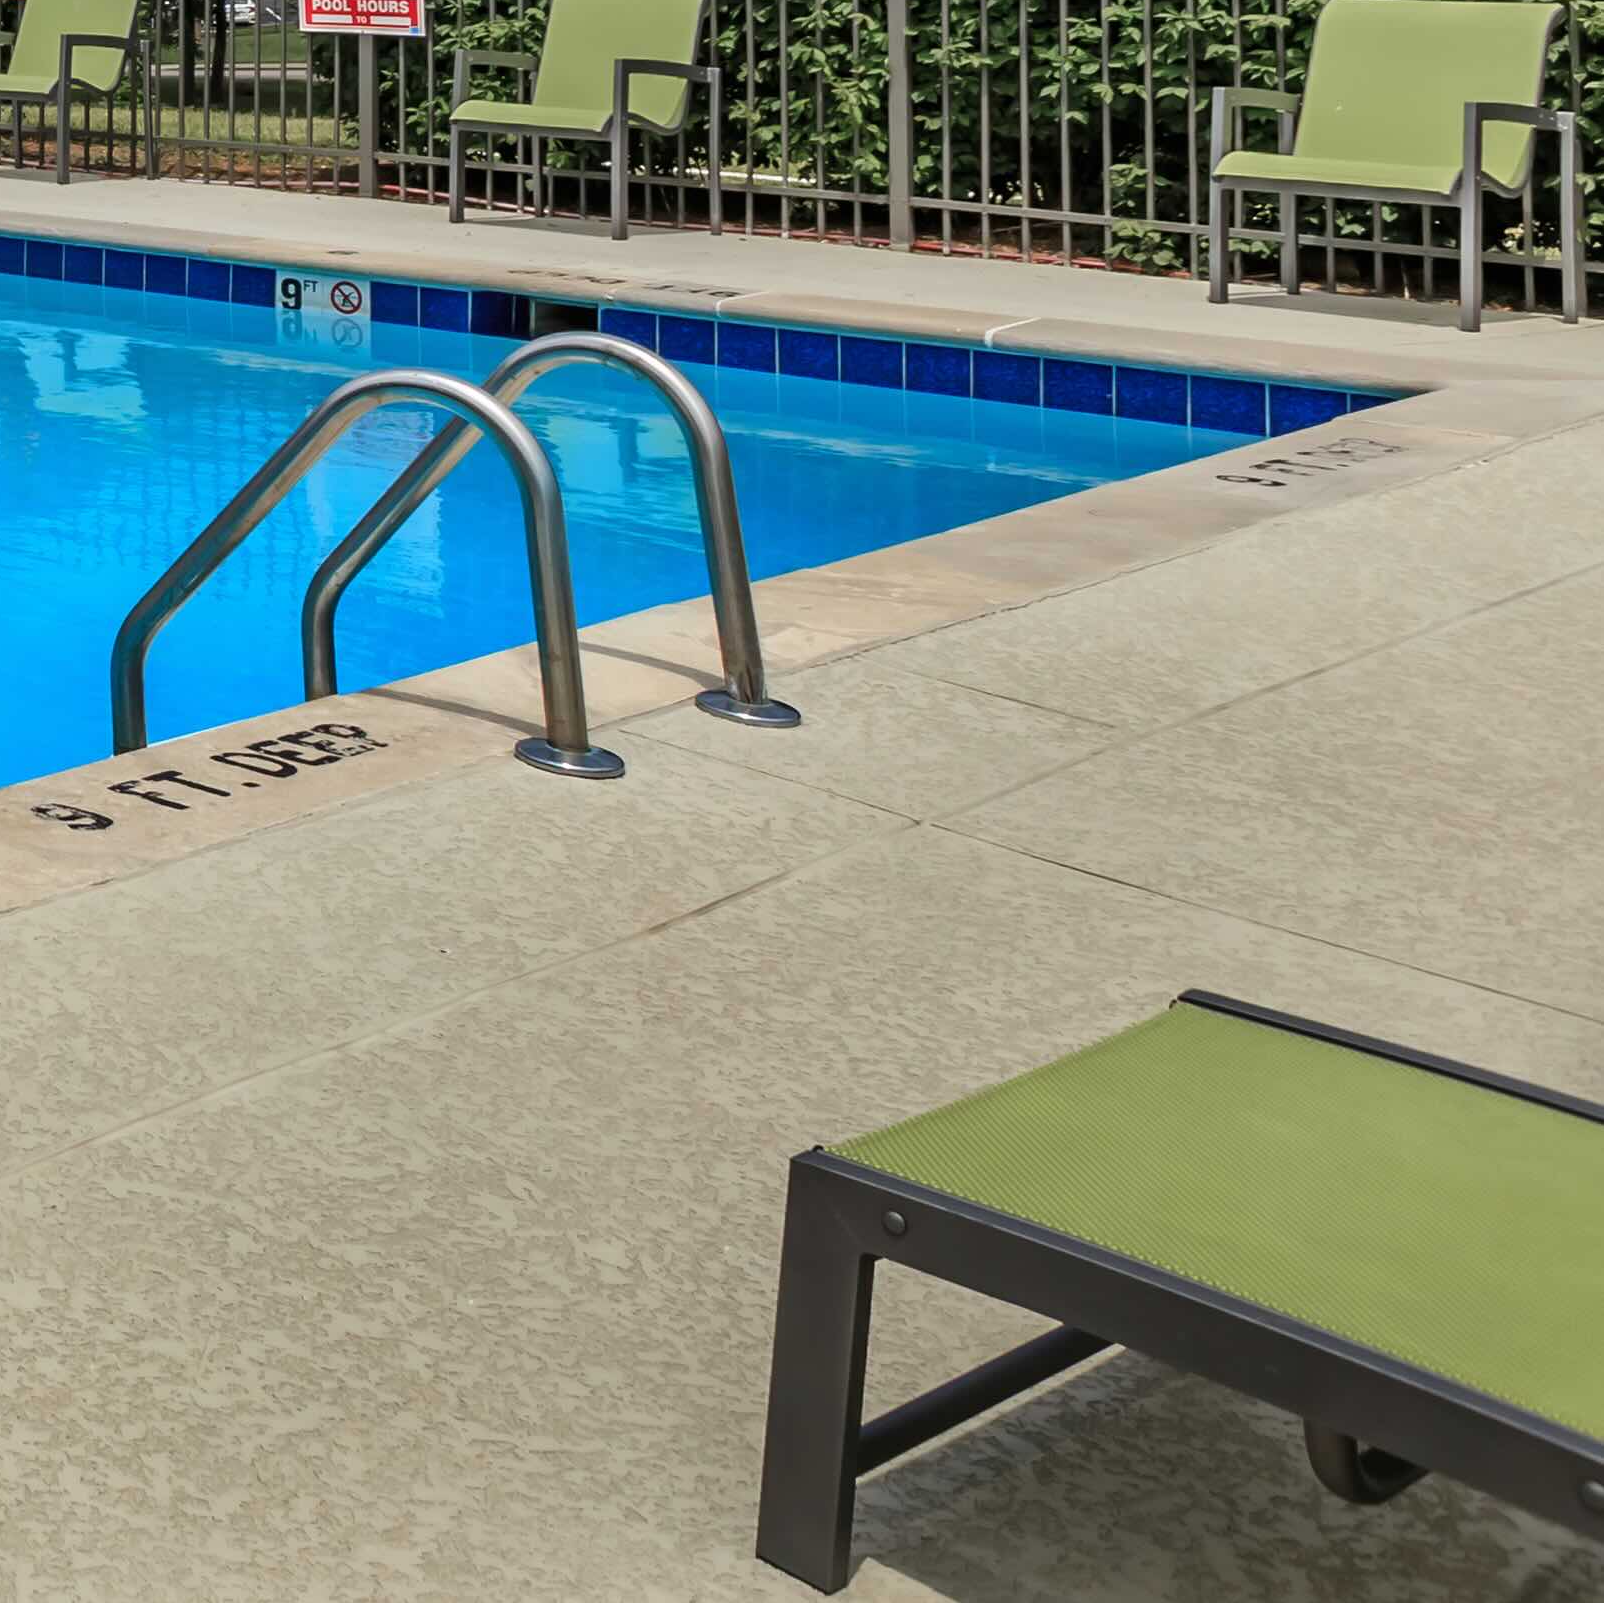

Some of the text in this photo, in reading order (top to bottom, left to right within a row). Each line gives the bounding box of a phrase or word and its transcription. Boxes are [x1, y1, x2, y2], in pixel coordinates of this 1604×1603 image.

[357, 0, 410, 14] HOURS
[356, 16, 367, 24] TO
[281, 278, 319, 310] 9 FT
[30, 802, 115, 831] 9
[209, 722, 390, 779] DEEP
